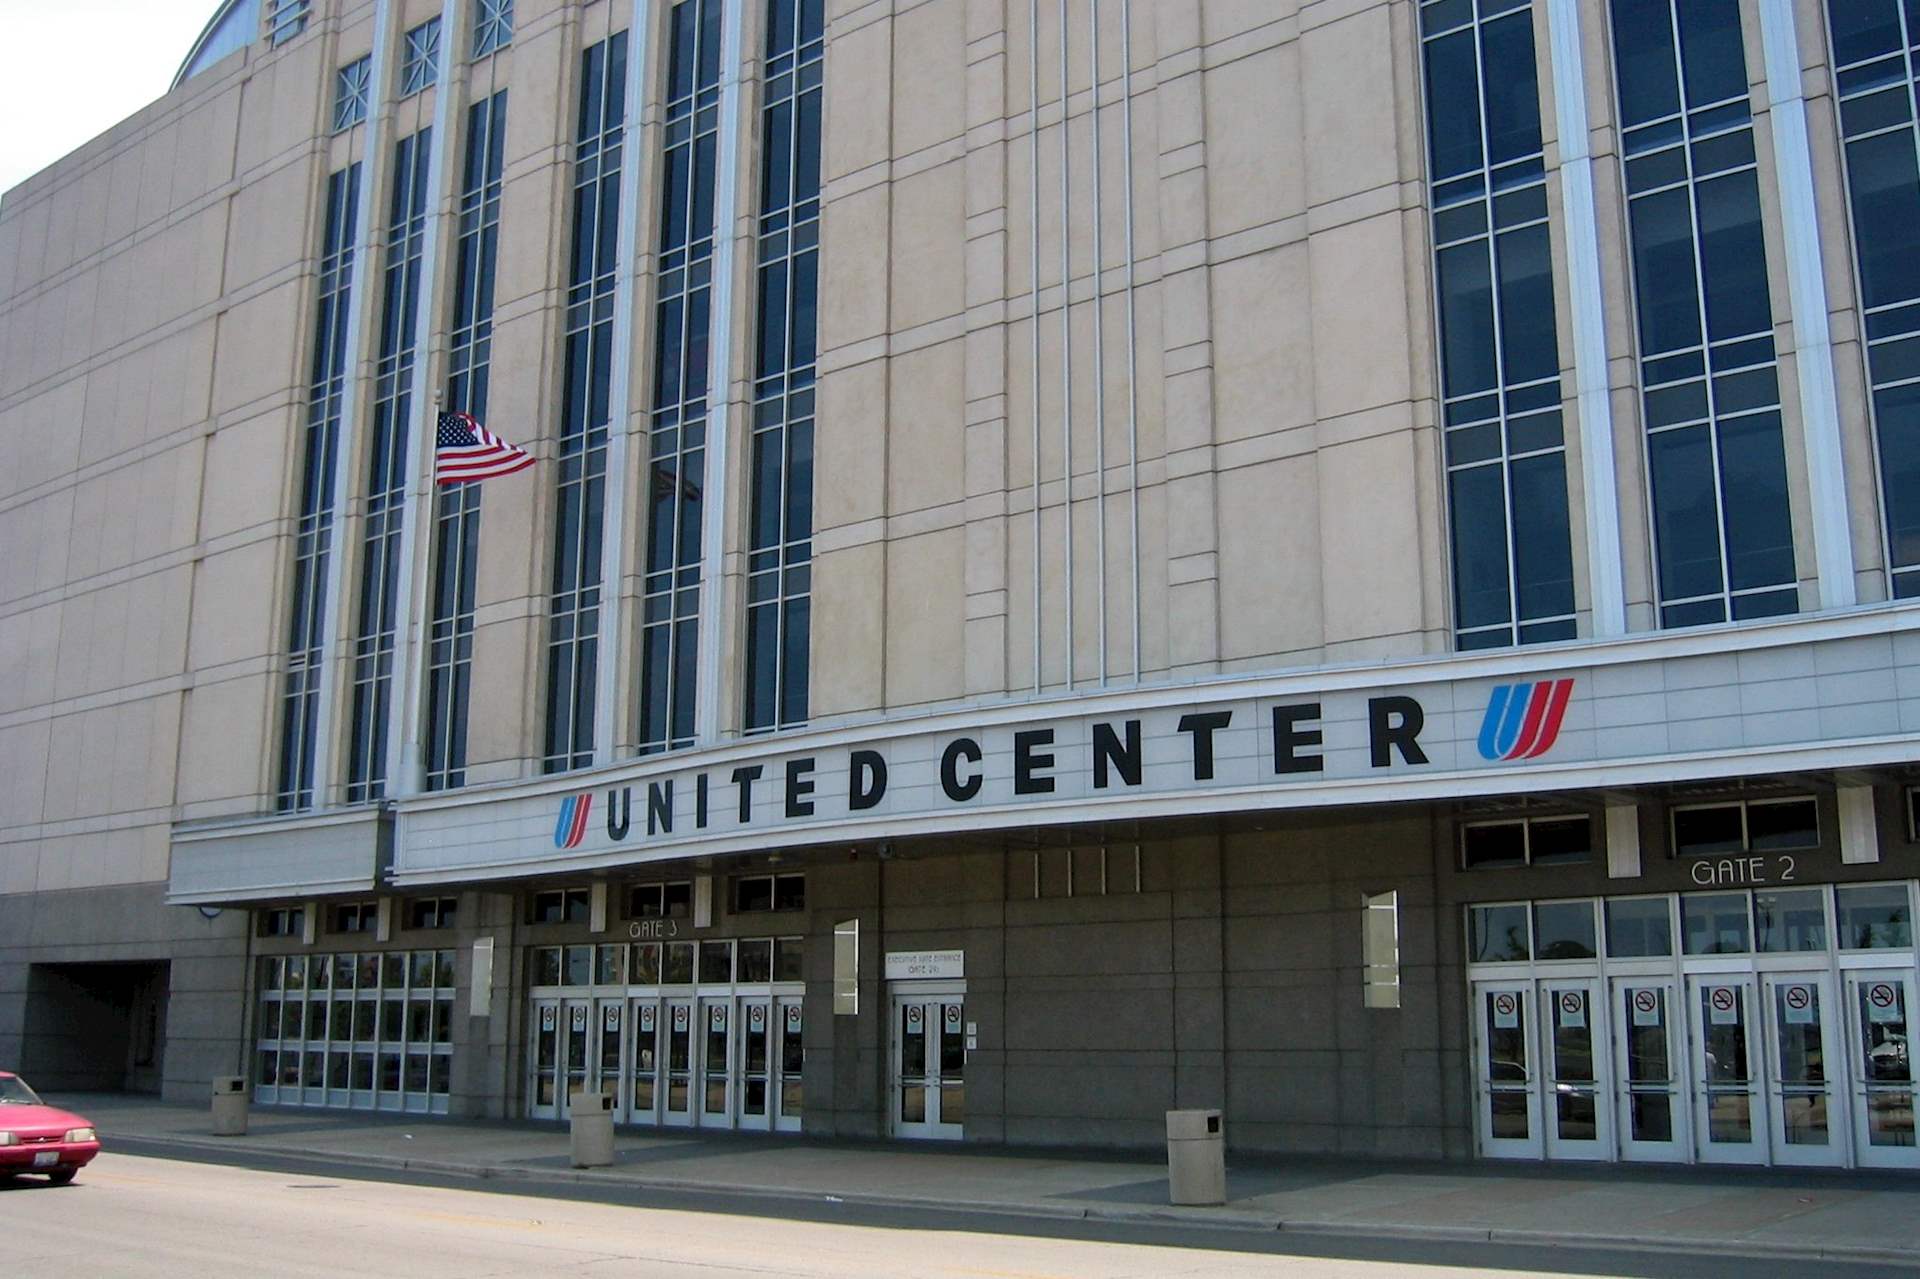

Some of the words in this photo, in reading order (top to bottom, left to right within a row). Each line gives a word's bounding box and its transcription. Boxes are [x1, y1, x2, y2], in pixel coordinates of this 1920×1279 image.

[607, 749, 888, 842] UNITED
[940, 696, 1430, 802] CENTER
[1691, 857, 1765, 885] GATE
[1779, 855, 1795, 880] 2
[629, 920, 664, 938] GATE
[668, 919, 678, 937] 3
